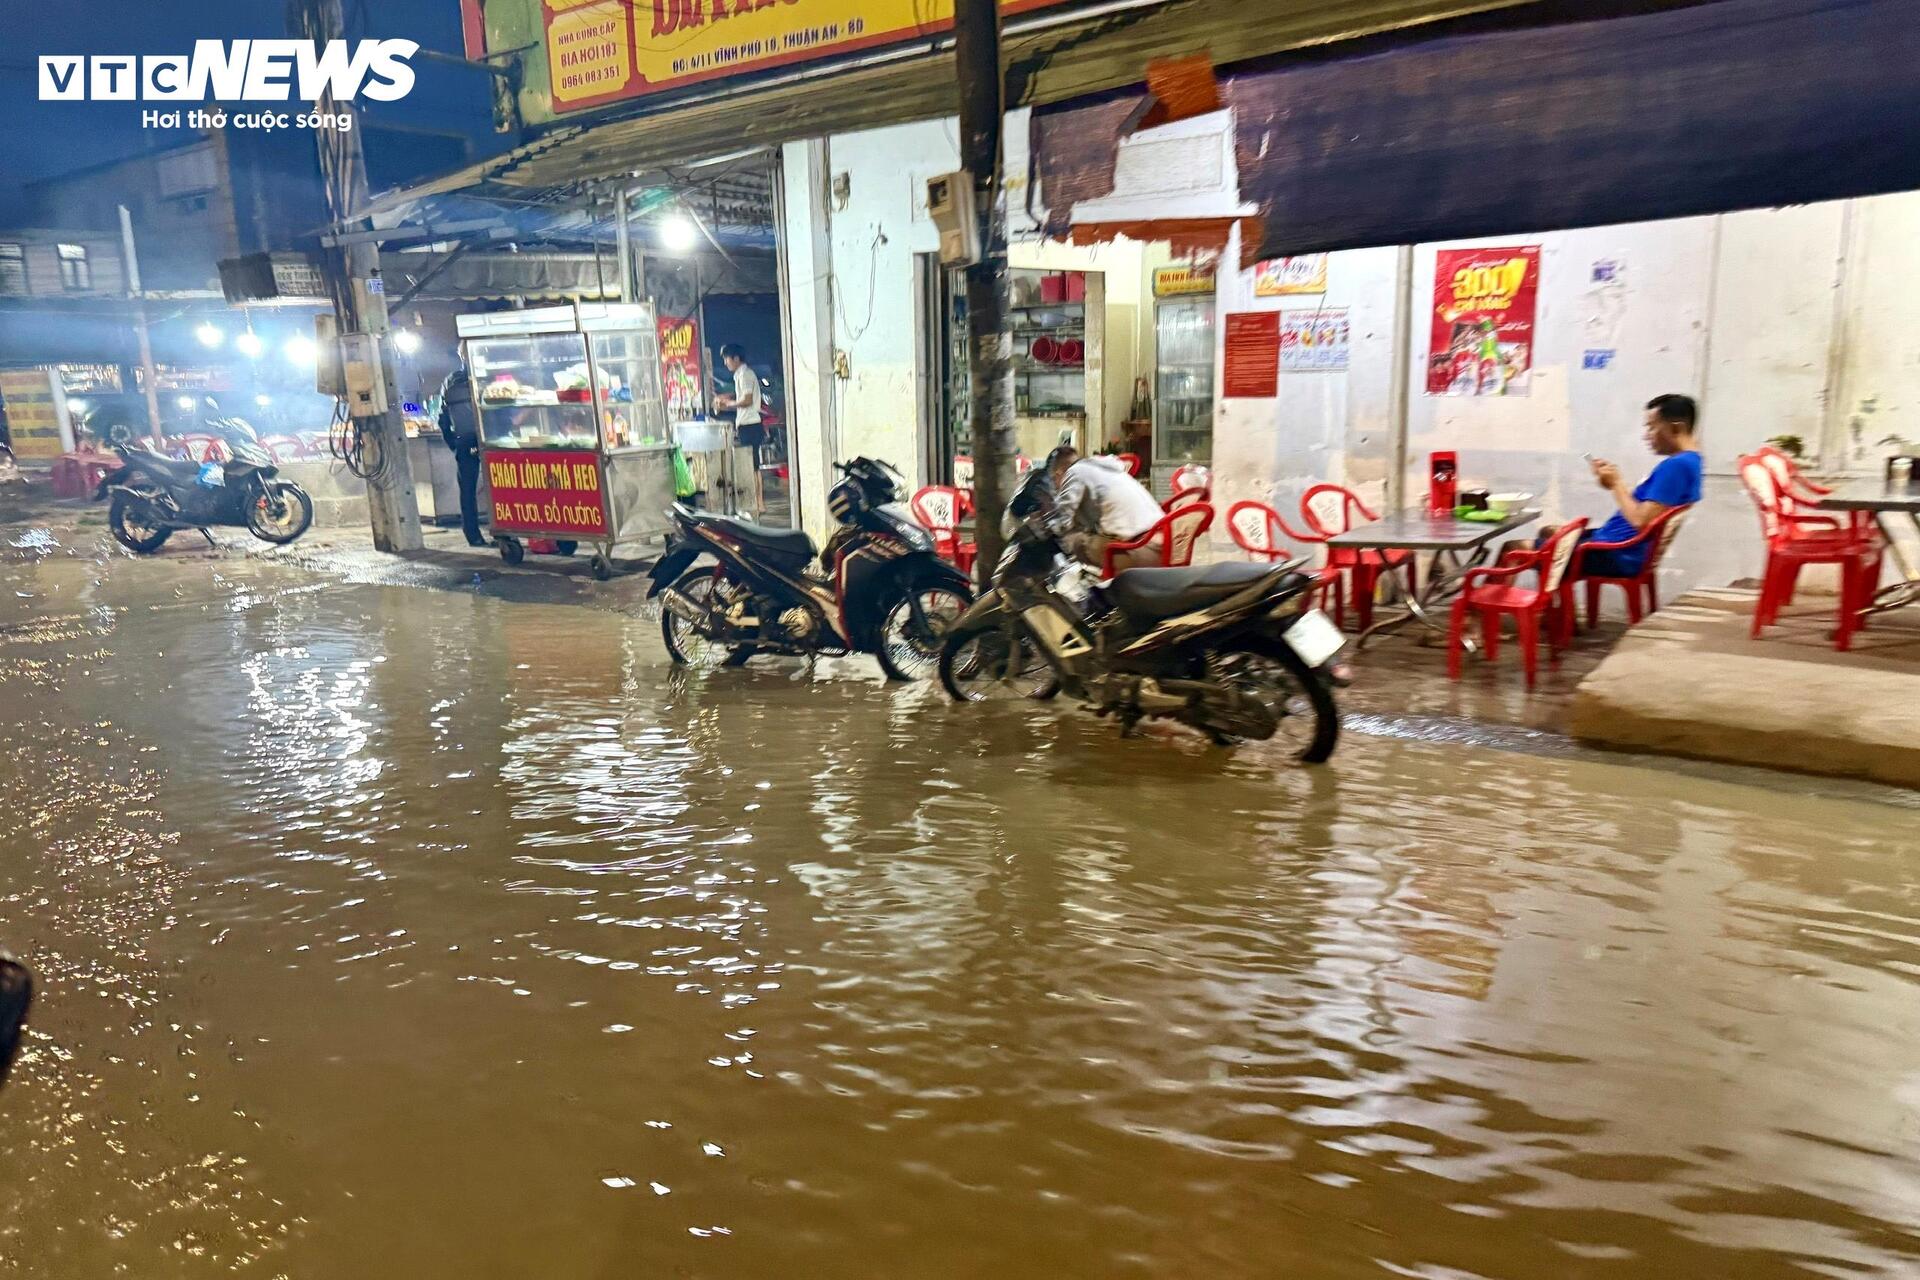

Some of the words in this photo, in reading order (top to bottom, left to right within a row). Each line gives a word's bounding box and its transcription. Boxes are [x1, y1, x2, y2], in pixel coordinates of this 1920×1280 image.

[561, 51, 578, 67] BIA
[580, 44, 599, 63] HƠI
[714, 46, 738, 64] VĨNH
[783, 28, 818, 48] THUẬN
[822, 24, 838, 41] AN
[490, 458, 518, 489] CHÁO
[520, 458, 548, 490] LÒNG
[550, 458, 571, 490] MÁ
[573, 464, 598, 491] HEO
[495, 502, 513, 521] BIA
[544, 496, 561, 524] ĐỒ
